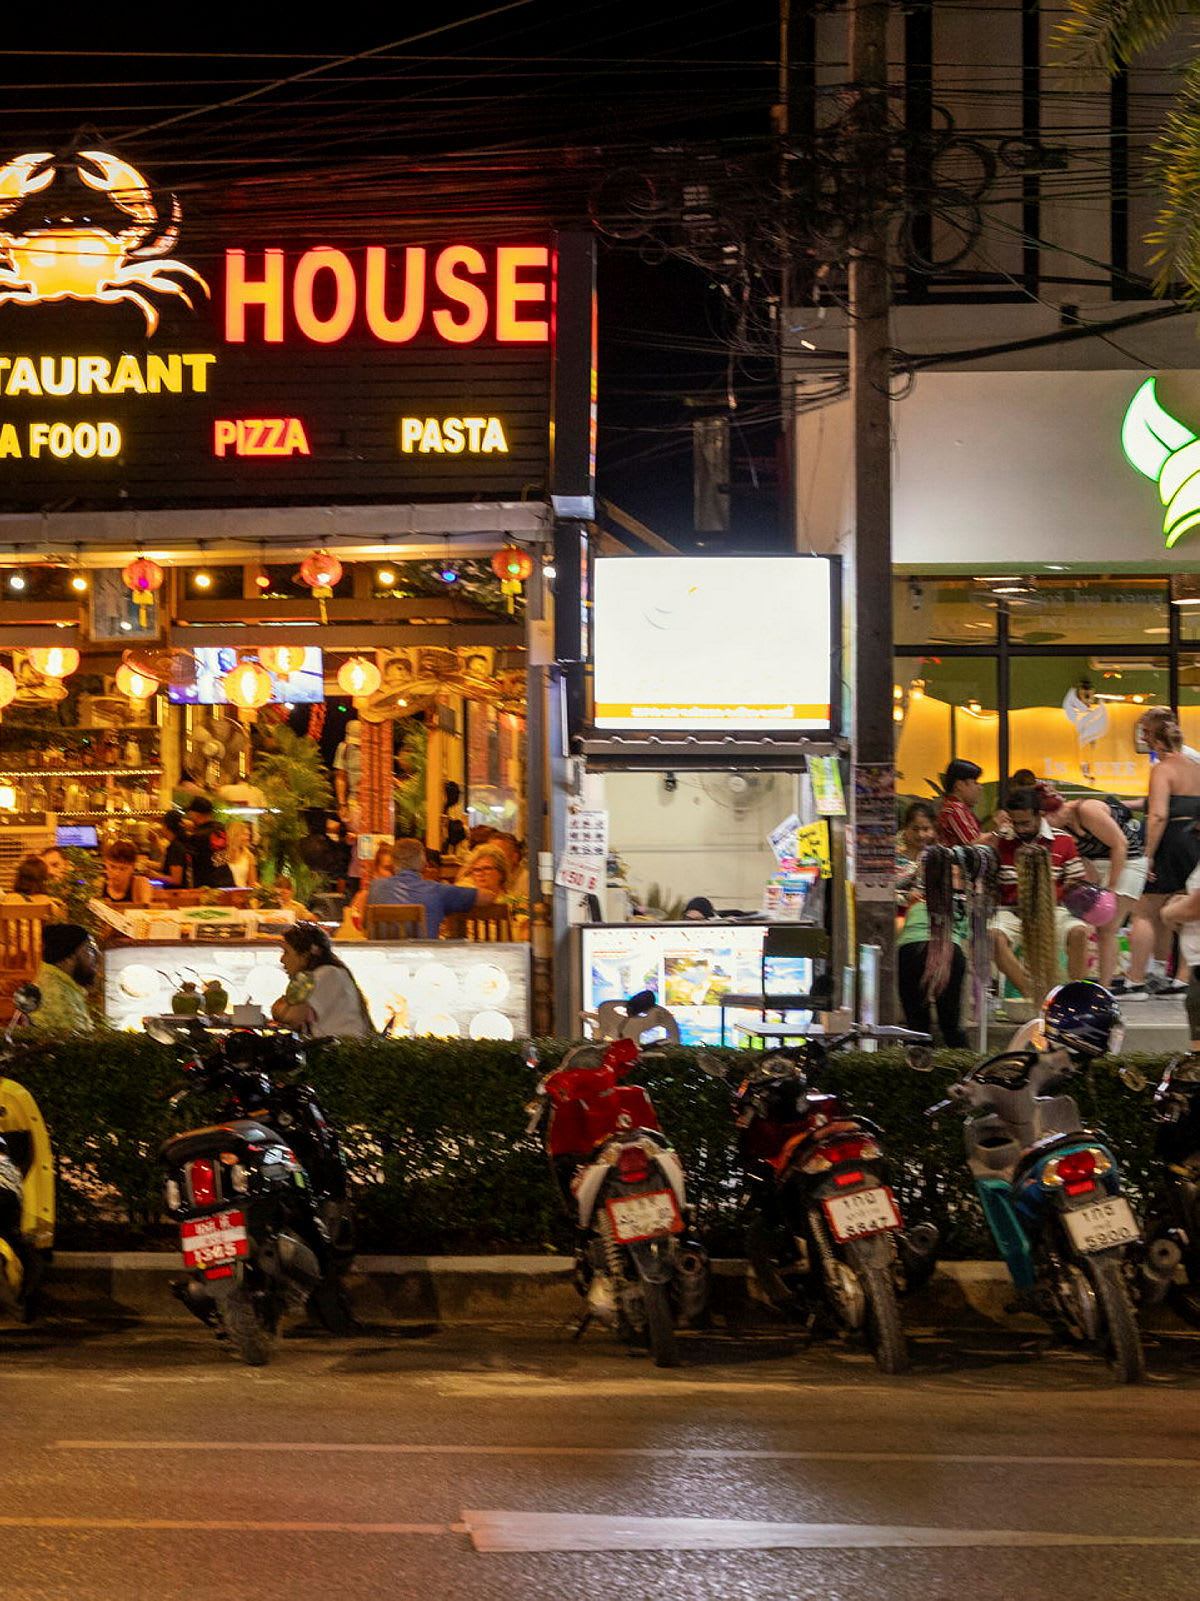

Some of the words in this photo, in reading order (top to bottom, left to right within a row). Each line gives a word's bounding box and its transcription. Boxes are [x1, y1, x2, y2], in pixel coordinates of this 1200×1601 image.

[224, 244, 549, 344] HOUSE
[29, 421, 122, 459] FOOD
[213, 417, 311, 457] PIZZA
[401, 416, 509, 454] PASTA
